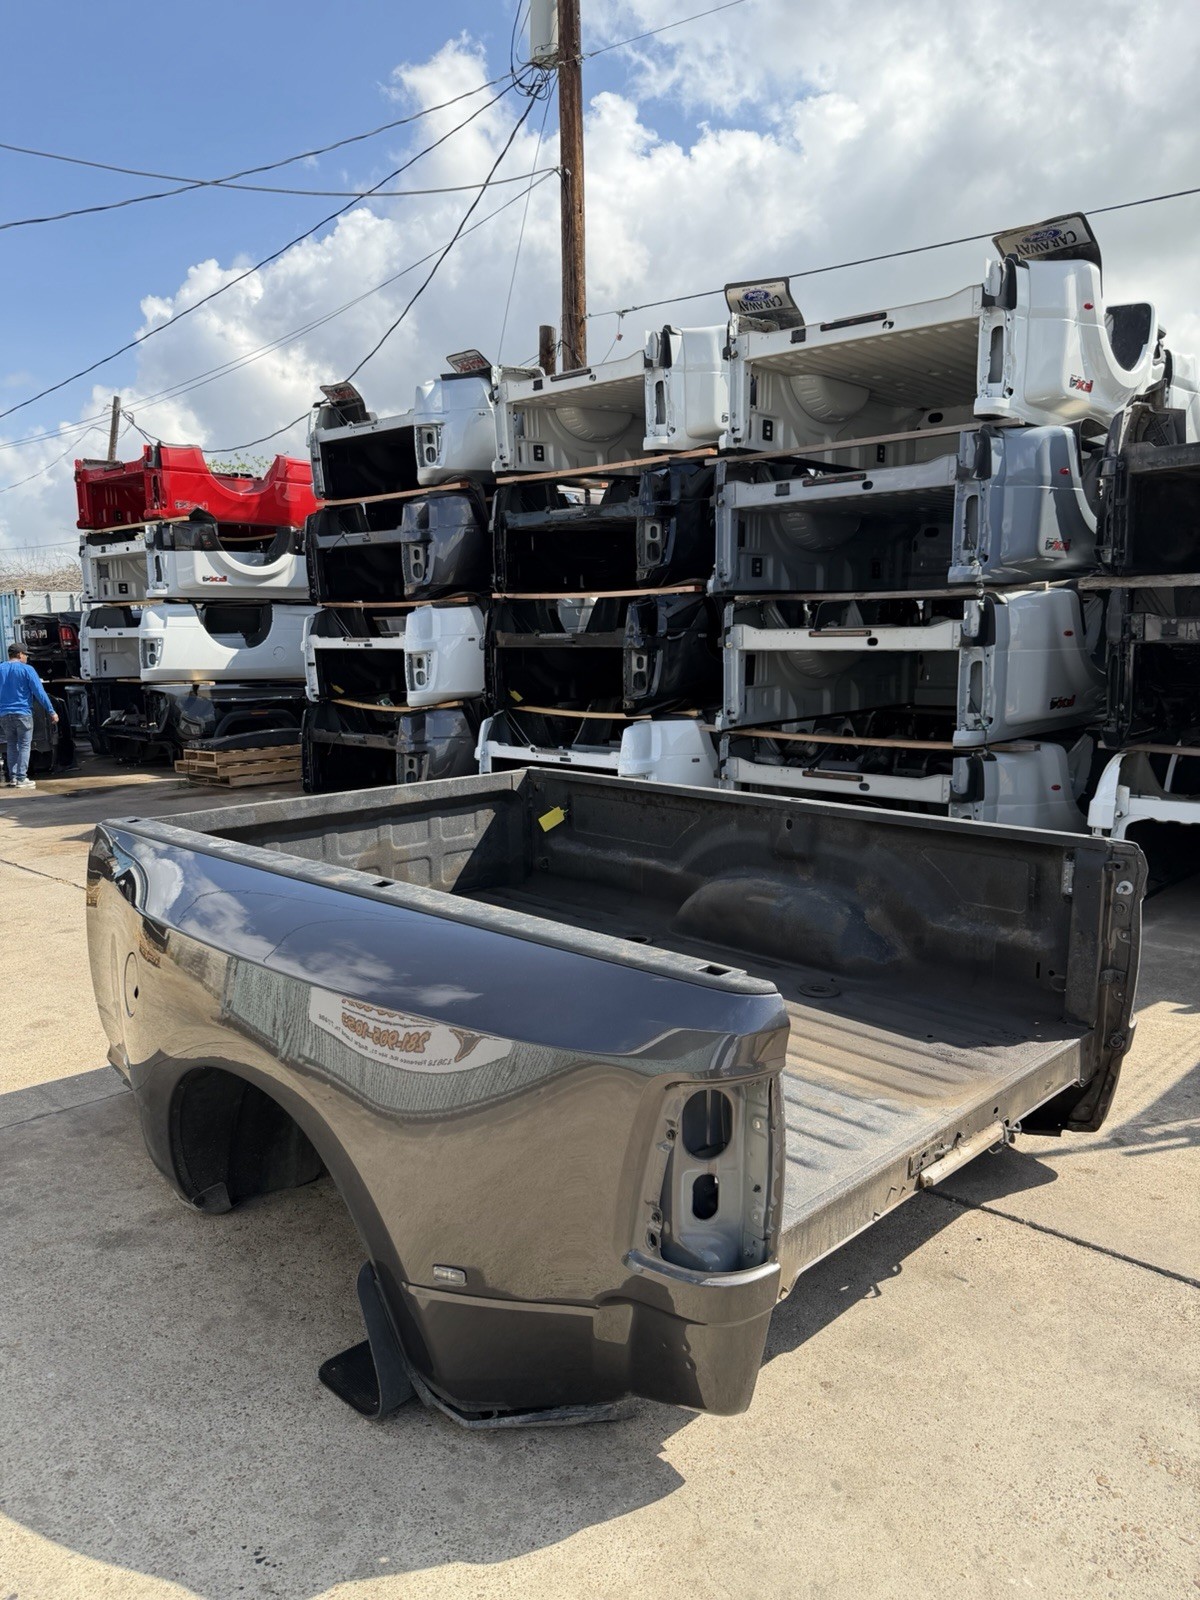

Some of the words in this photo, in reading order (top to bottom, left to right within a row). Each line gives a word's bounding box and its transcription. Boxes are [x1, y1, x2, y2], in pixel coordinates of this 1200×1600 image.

[1014, 230, 1077, 256] CARAWAY
[737, 295, 783, 312] CARAWAY
[22, 629, 48, 639] RAM
